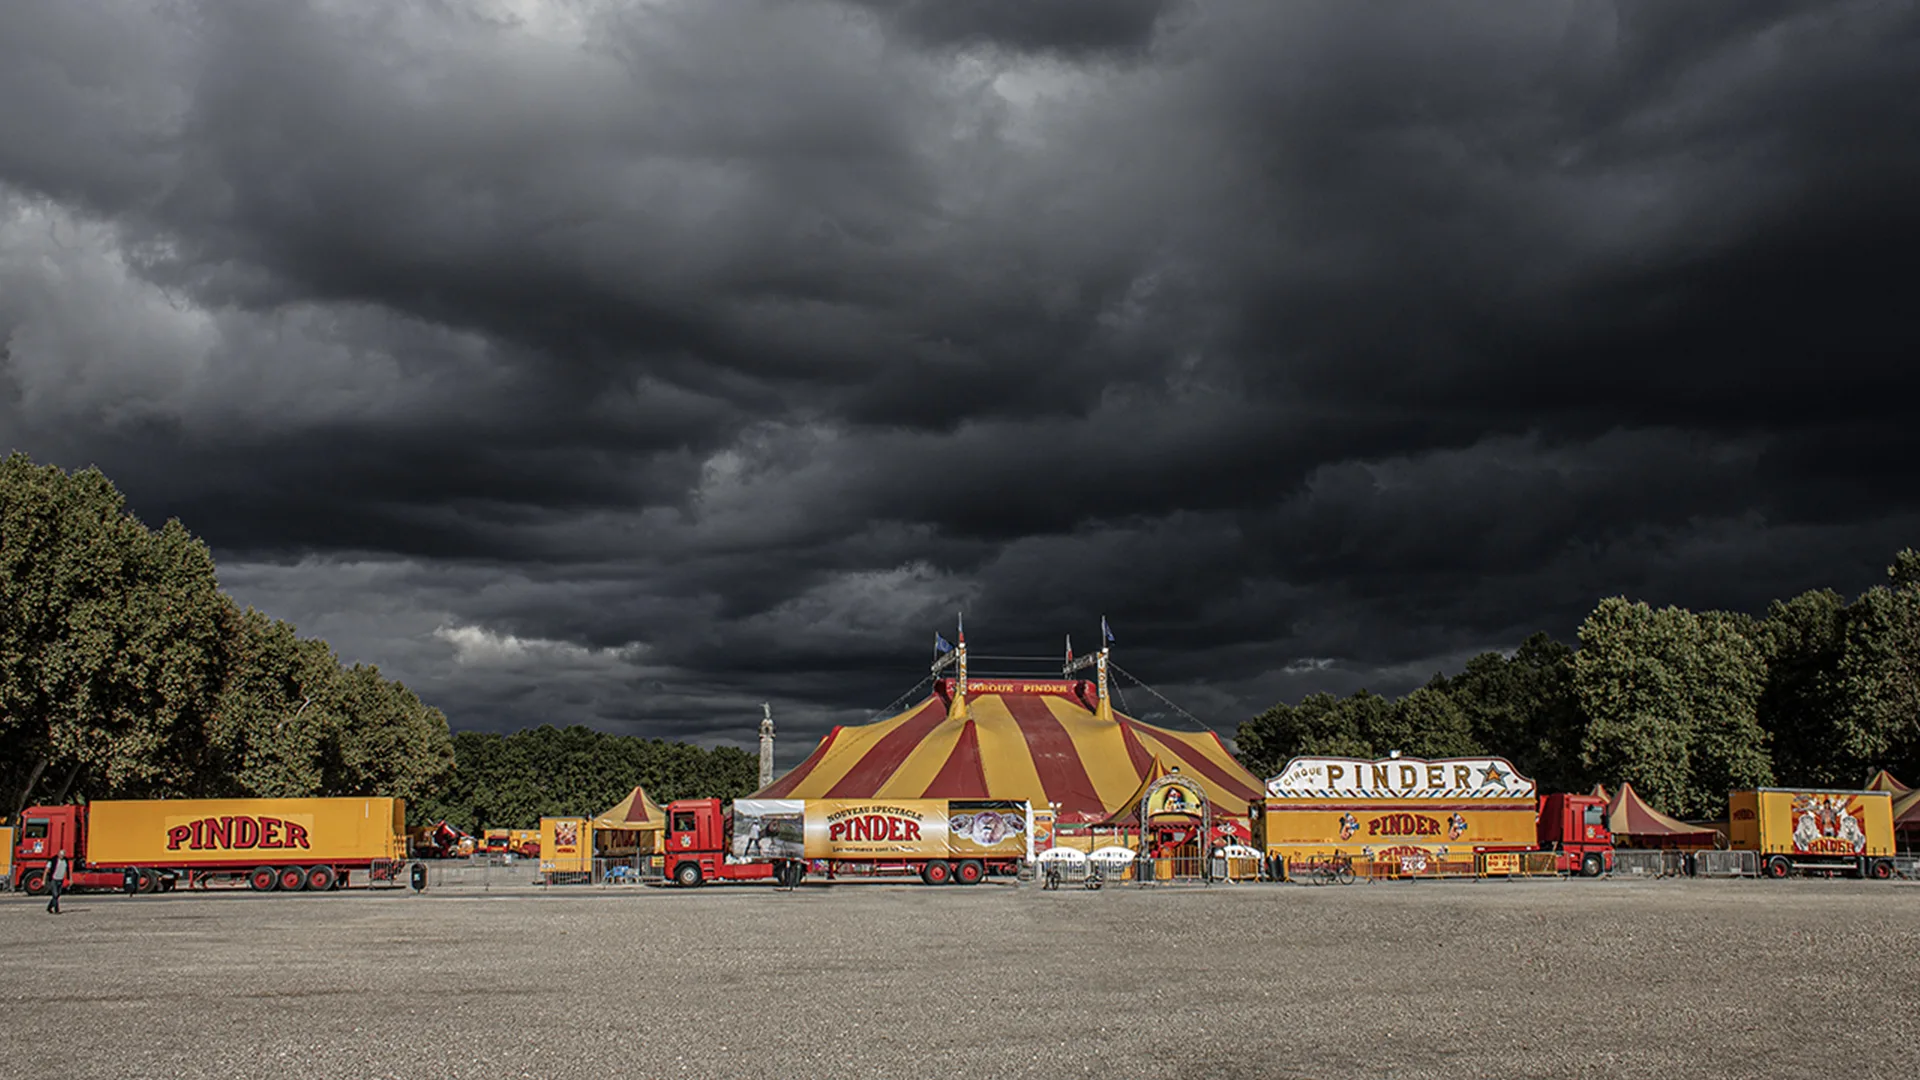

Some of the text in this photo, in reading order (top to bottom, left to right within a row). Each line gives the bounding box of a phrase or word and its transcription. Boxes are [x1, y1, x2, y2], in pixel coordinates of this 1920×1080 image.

[1023, 684, 1067, 693] PINDER
[1283, 764, 1472, 789] CIRQUE PINDER
[827, 806, 924, 822] NOUVEAU SPECTACLE
[167, 816, 310, 850] PINDER
[829, 815, 922, 842] PINDER
[1368, 813, 1442, 836] PINDER
[1808, 837, 1856, 853] PINDER
[1402, 860, 1427, 871] ZOO
